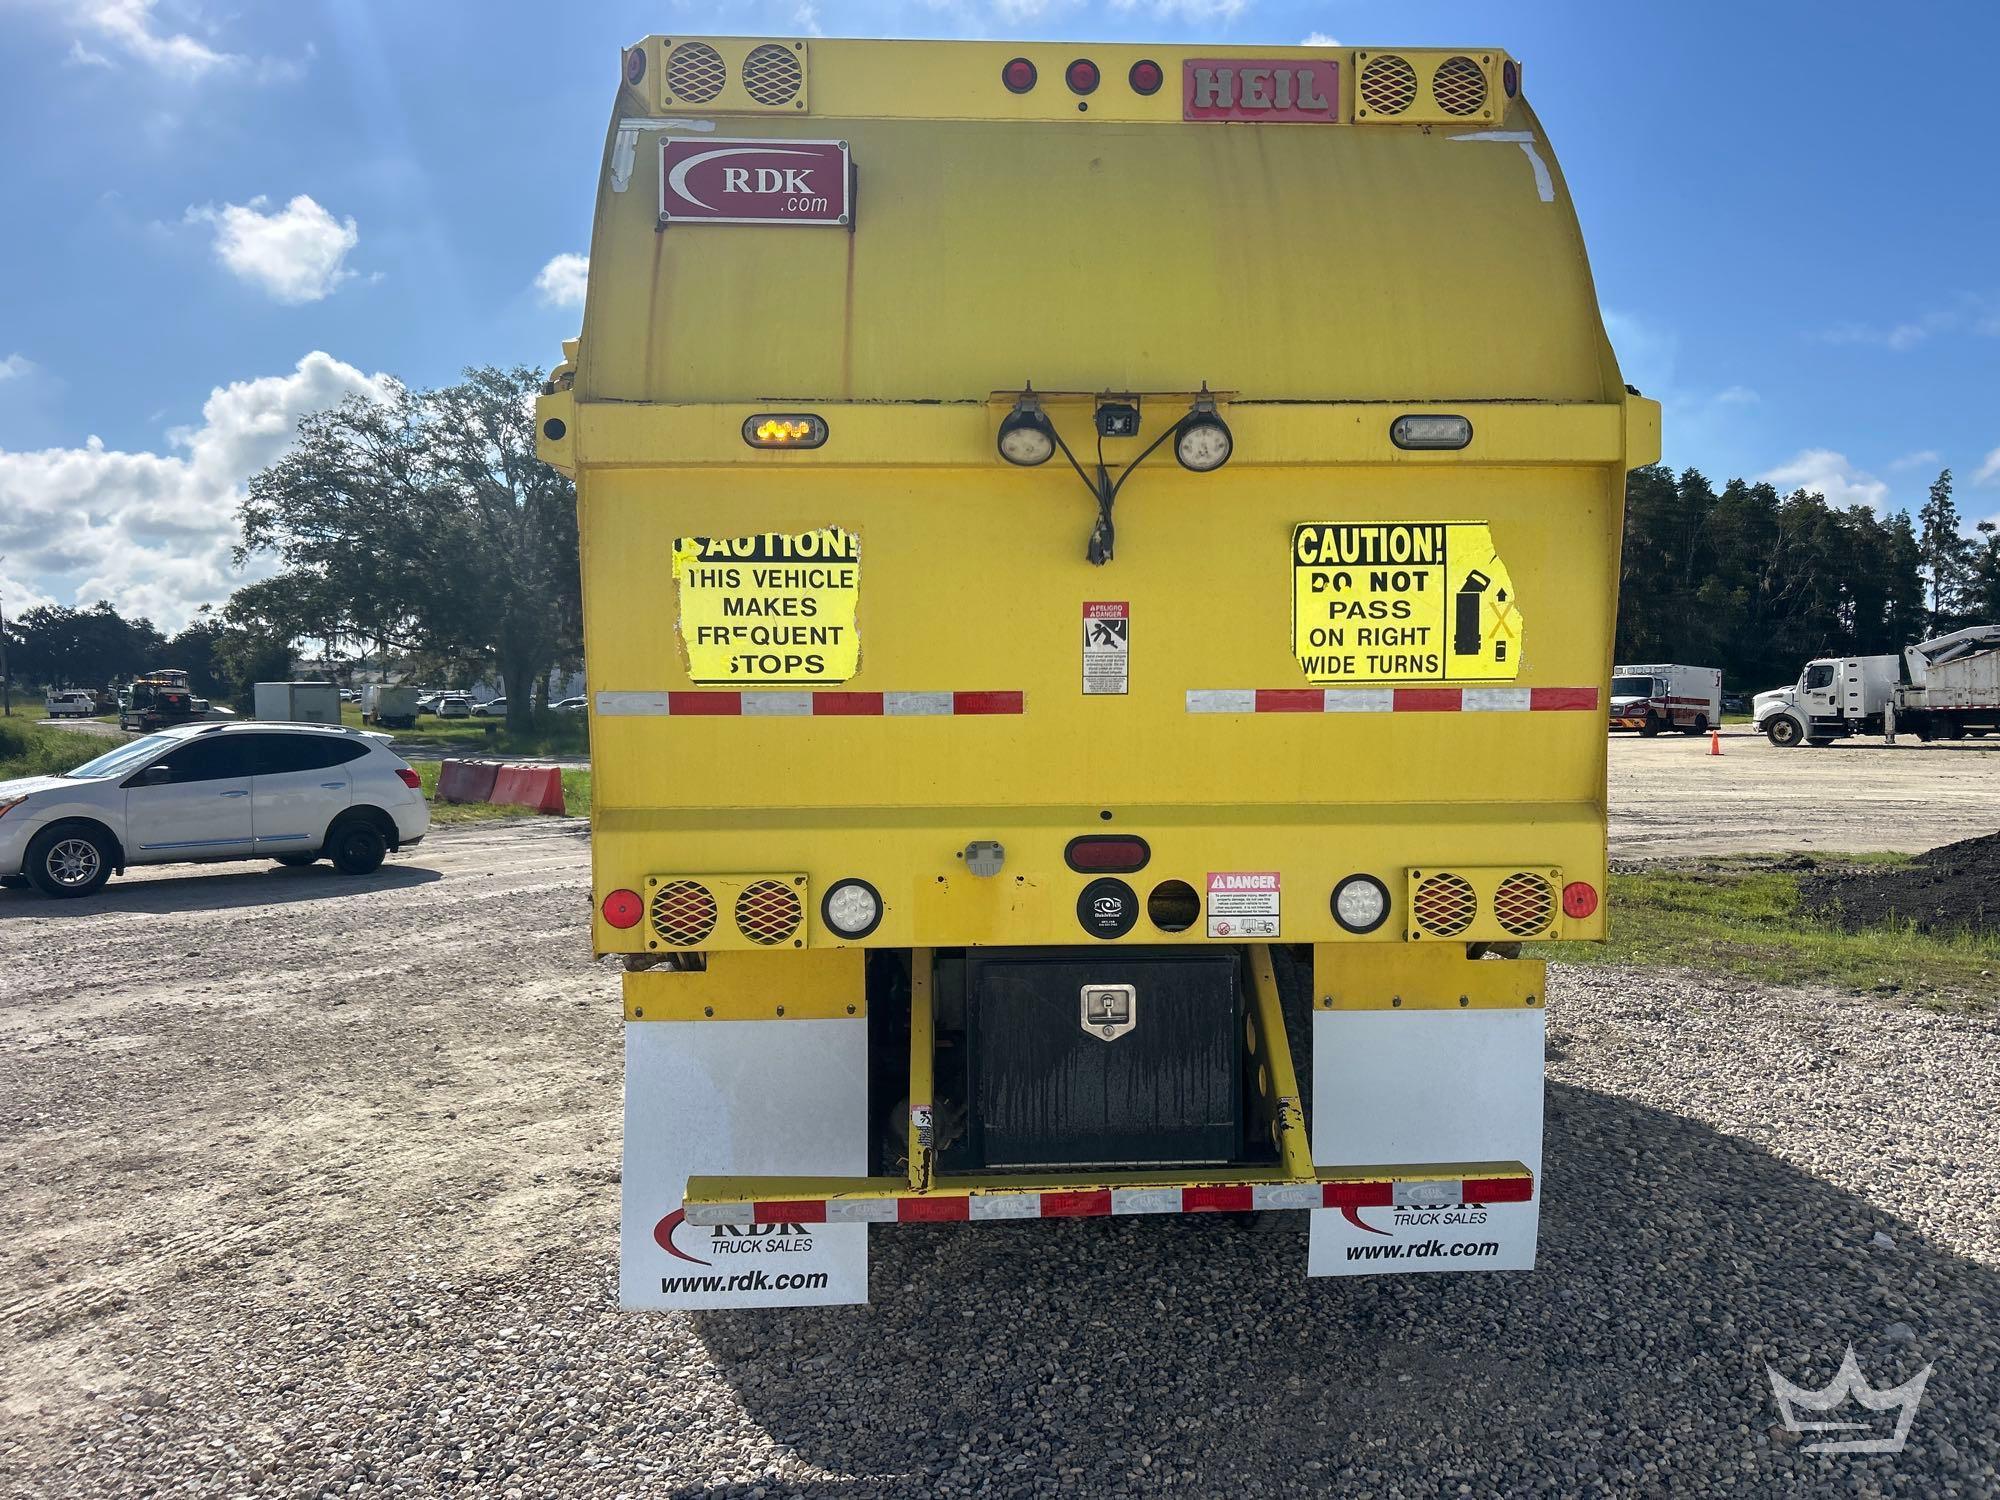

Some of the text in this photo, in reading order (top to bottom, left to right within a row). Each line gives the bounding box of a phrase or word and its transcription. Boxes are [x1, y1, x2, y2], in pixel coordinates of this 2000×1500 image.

[1193, 68, 1329, 110] HEIL
[722, 167, 816, 195] RDK
[780, 196, 828, 212] .com
[1297, 526, 1444, 564] CAUTION!
[752, 569, 855, 589] VEHICLE
[1311, 571, 1429, 593] DO NOT
[723, 597, 817, 617] MAKES
[1329, 600, 1411, 620] PASS
[697, 626, 844, 646] FREQUENT
[1309, 627, 1431, 647] ON RIGHT
[1301, 654, 1439, 674] WIDE TURNS
[1226, 875, 1276, 889] DANGER
[1394, 1212, 1488, 1226] TRUCK SALES
[711, 1238, 813, 1254] TRUCK SALES
[1346, 1239, 1500, 1261] www.rdk.com
[660, 1270, 828, 1294] www.rdk.com
